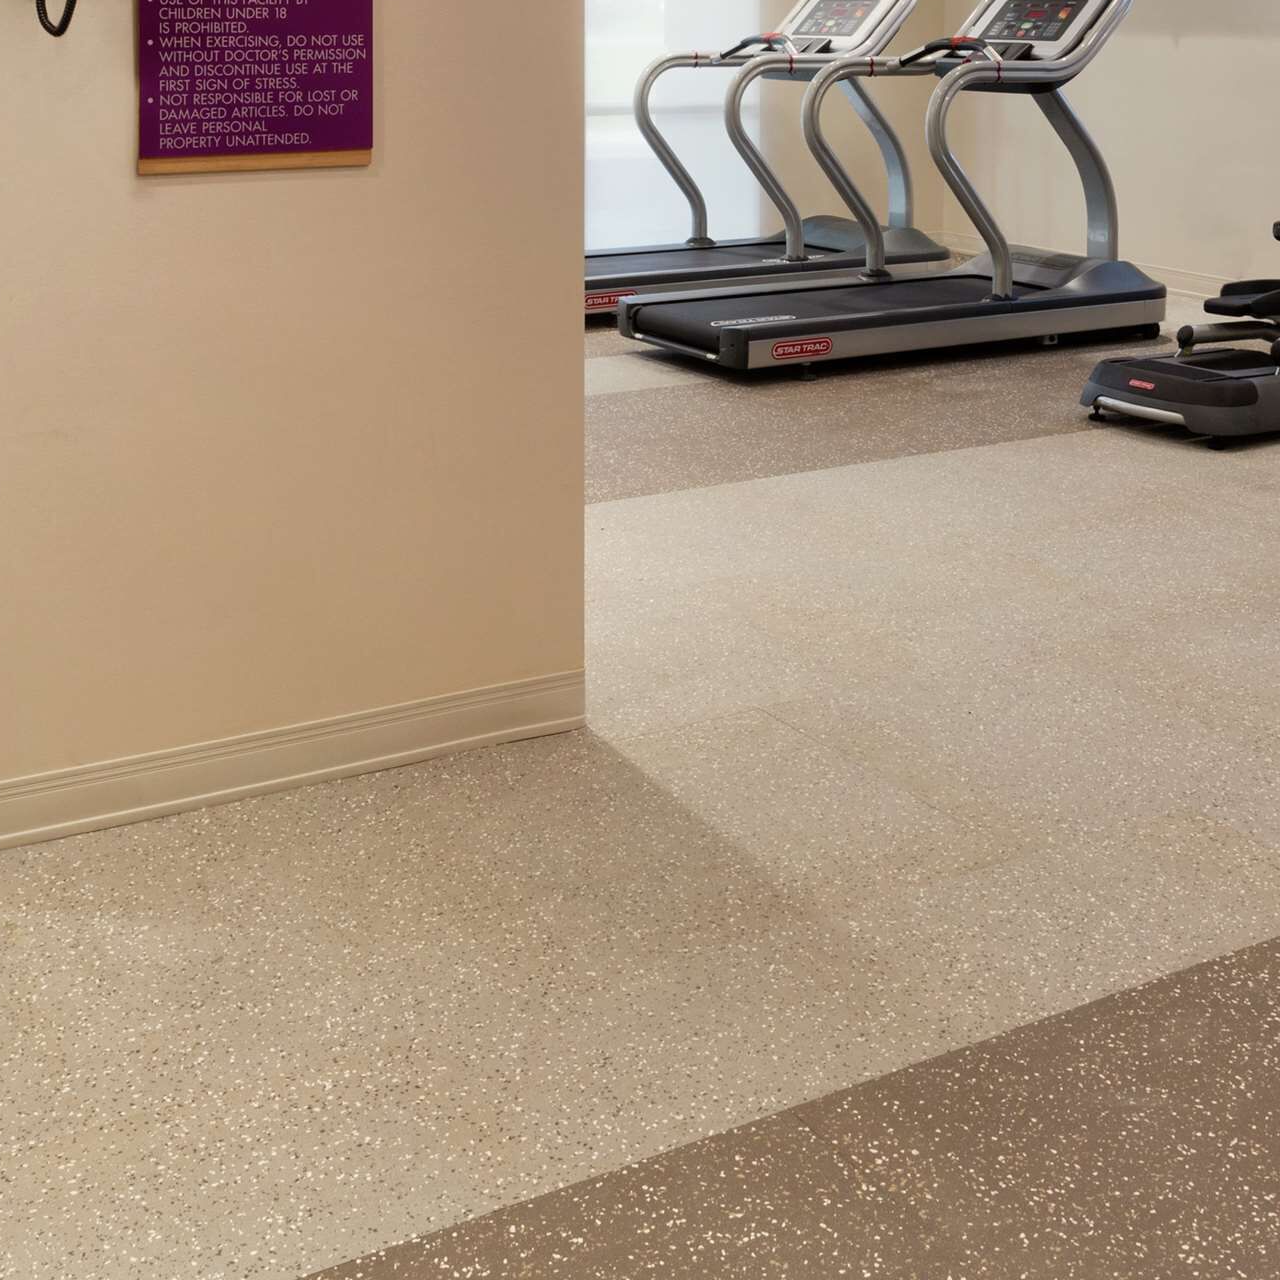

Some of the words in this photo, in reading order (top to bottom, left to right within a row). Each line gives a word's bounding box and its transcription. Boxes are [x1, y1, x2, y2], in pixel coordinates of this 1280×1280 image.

[159, 8, 220, 19] CHILDREN
[226, 7, 268, 19] UNDER
[275, 8, 286, 19] 18
[160, 22, 169, 34] IS
[175, 22, 249, 33] PROHIBITED.
[160, 37, 201, 48] WHEN
[207, 36, 282, 49] EXERCISING,
[287, 35, 306, 46] DO
[312, 35, 337, 46] NOT
[342, 35, 364, 46] USE
[160, 50, 219, 62] WITHOUT
[225, 49, 289, 61] DOCTOR'S
[294, 48, 365, 61] PERMISSION
[160, 65, 189, 76] AND
[195, 64, 280, 76] DISCONTINUE
[286, 63, 308, 75] USE
[313, 63, 328, 74] AT
[332, 62, 353, 74] THE
[160, 80, 189, 91] FIRST
[196, 79, 227, 90] SIGN
[233, 78, 250, 90] OF
[255, 78, 299, 89] STRESS.
[160, 94, 187, 105] NOT
[194, 92, 273, 105] RESPONSIBLE
[279, 91, 302, 102] FOR
[308, 91, 336, 102] LOST
[341, 90, 358, 101] OR
[160, 108, 226, 120] DAMAGED
[232, 106, 288, 118] ARTICLES.
[294, 105, 313, 117] DO
[318, 104, 344, 115] NOT
[160, 123, 196, 134] LEAVE
[202, 121, 267, 133] PERSONAL
[160, 136, 220, 149] PROPERTY
[226, 133, 312, 147] UNATTENDED.
[776, 346, 800, 354] STAR
[802, 342, 828, 352] TRAC
